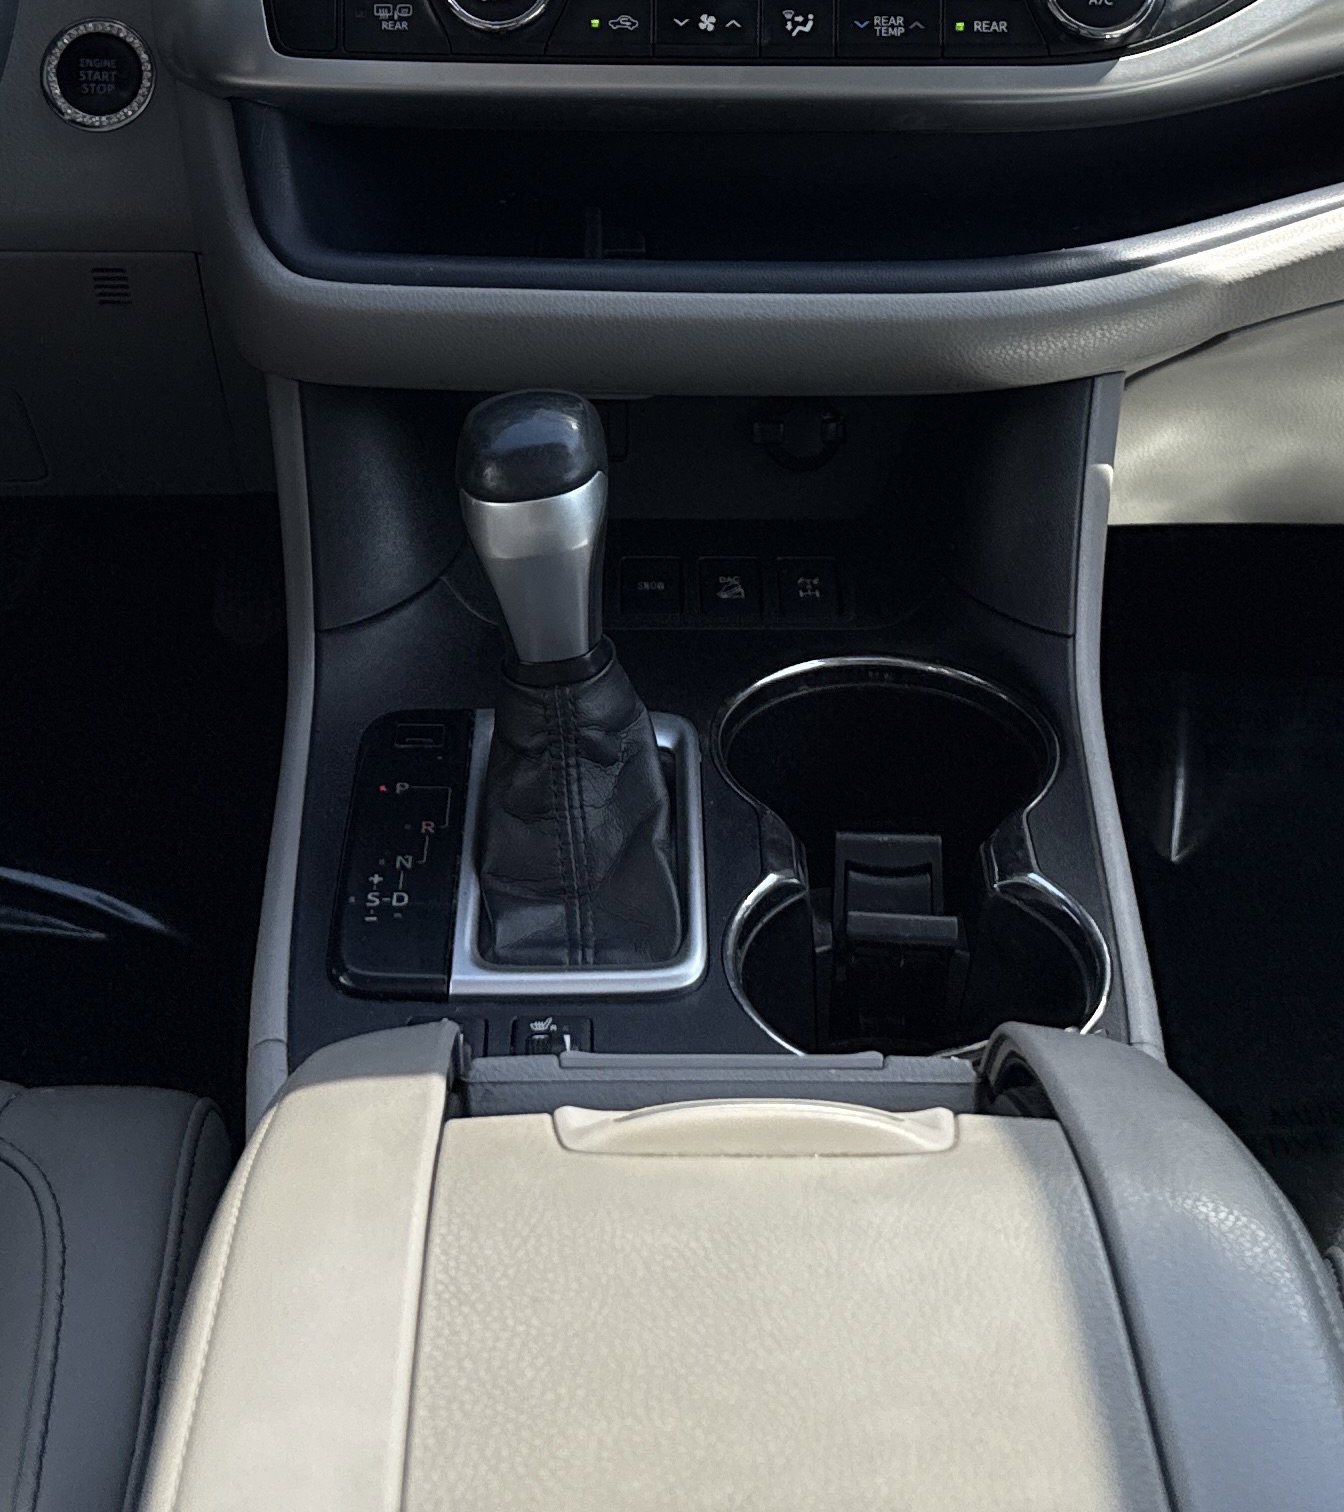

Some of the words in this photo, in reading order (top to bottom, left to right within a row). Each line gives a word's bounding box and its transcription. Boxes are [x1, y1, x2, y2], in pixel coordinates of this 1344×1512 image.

[381, 20, 408, 31] REAR
[874, 16, 904, 26] REAR
[974, 21, 1008, 33] REAR
[875, 27, 905, 37] TEMP
[79, 58, 116, 68] ENGINE
[79, 70, 117, 82] START
[81, 83, 115, 95] STOP
[637, 581, 665, 590] SNOW
[396, 782, 409, 794] P
[421, 820, 435, 834] R
[395, 855, 413, 869] N
[365, 891, 380, 907] S
[391, 891, 409, 907] D
